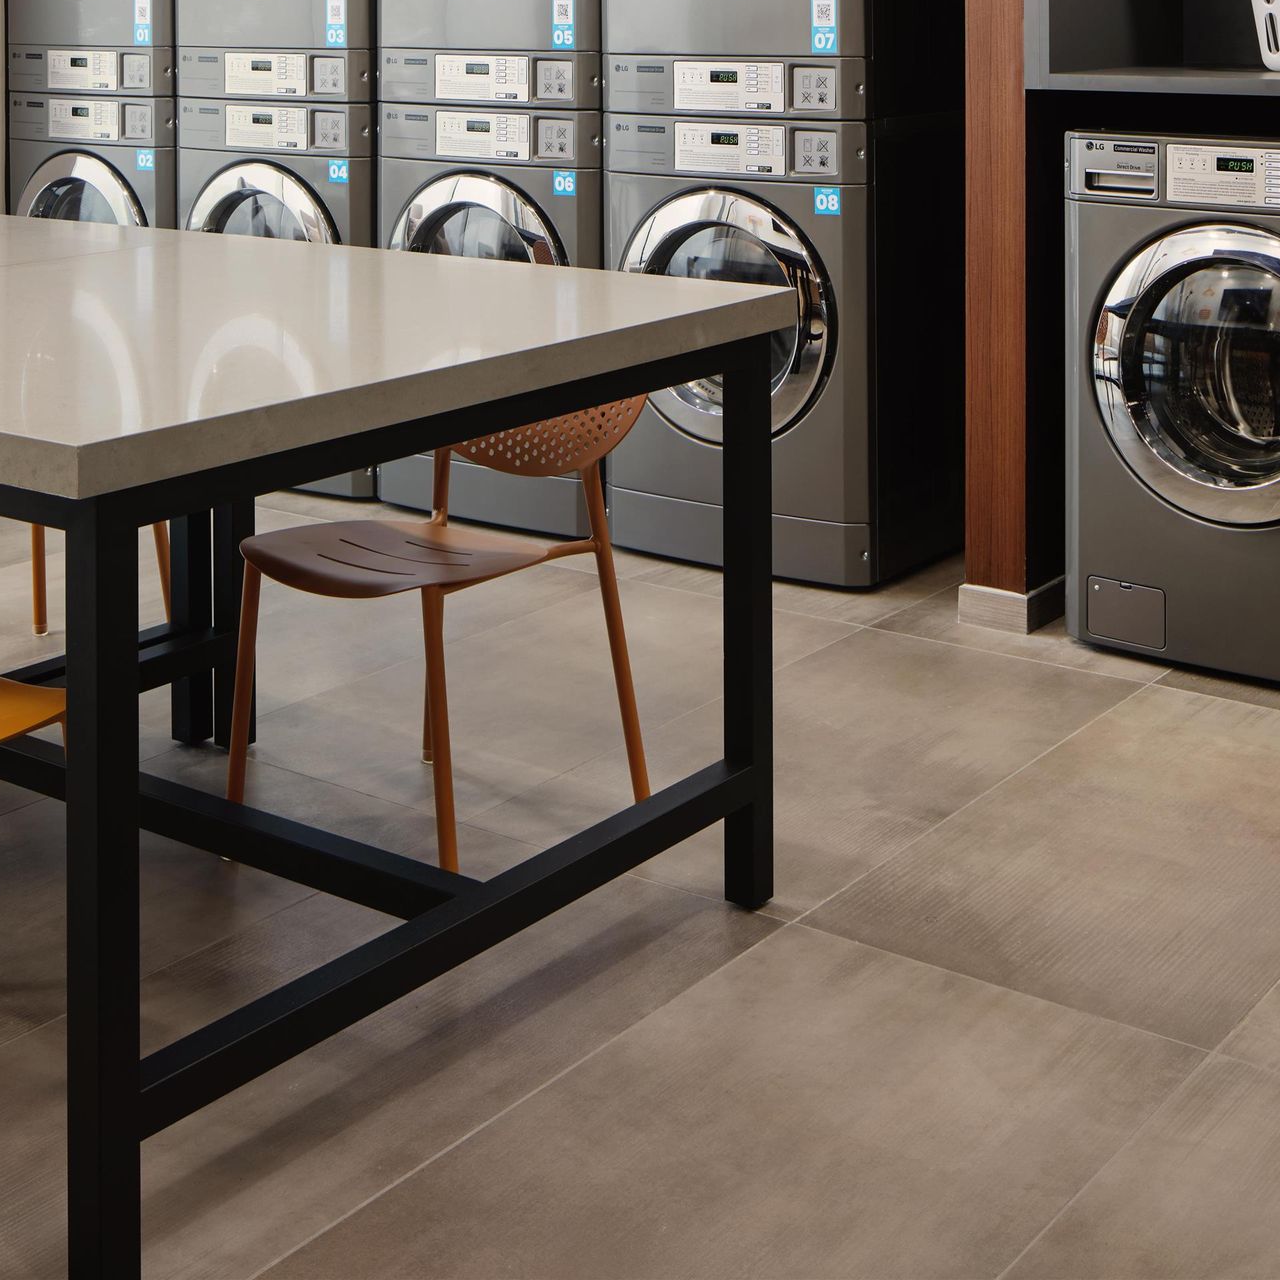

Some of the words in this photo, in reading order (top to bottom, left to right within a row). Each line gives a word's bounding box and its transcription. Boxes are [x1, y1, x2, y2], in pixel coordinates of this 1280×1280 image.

[136, 28, 149, 42] 01
[327, 29, 344, 43] 03
[553, 29, 573, 45] 05
[814, 32, 835, 49] 07
[138, 154, 153, 167] 02
[1228, 160, 1253, 171] PUSH
[329, 164, 348, 179] 04
[555, 176, 574, 192] 06
[816, 194, 839, 211] 08
